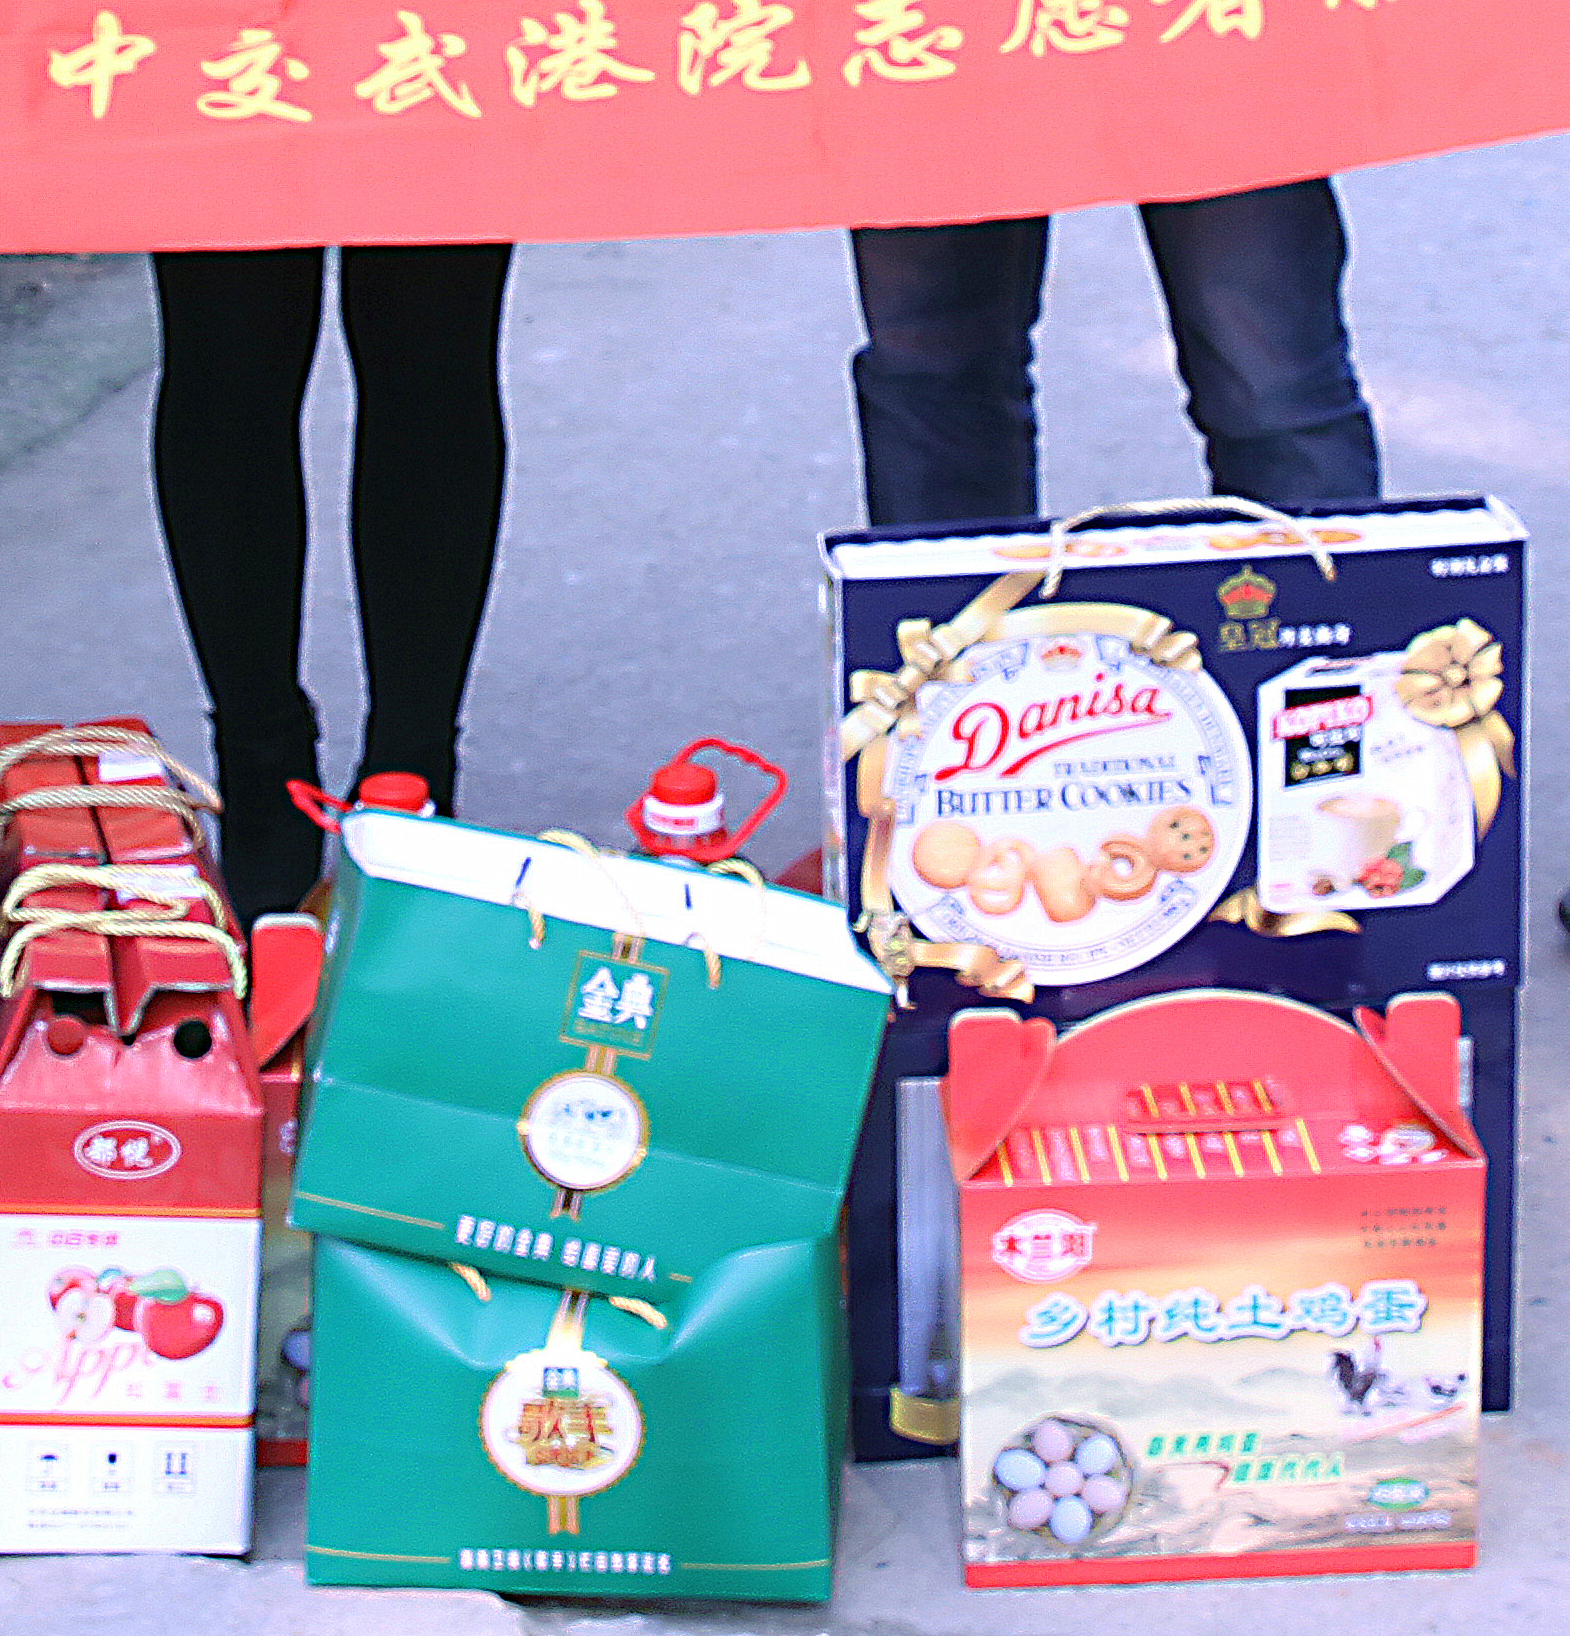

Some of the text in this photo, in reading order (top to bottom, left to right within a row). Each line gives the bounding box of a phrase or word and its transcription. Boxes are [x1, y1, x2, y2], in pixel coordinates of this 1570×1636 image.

[933, 672, 1173, 781] Danisa
[935, 777, 1193, 819] BUTTER COOKIES
[1021, 1282, 1427, 1346] 乡村纯土鸡蛋
